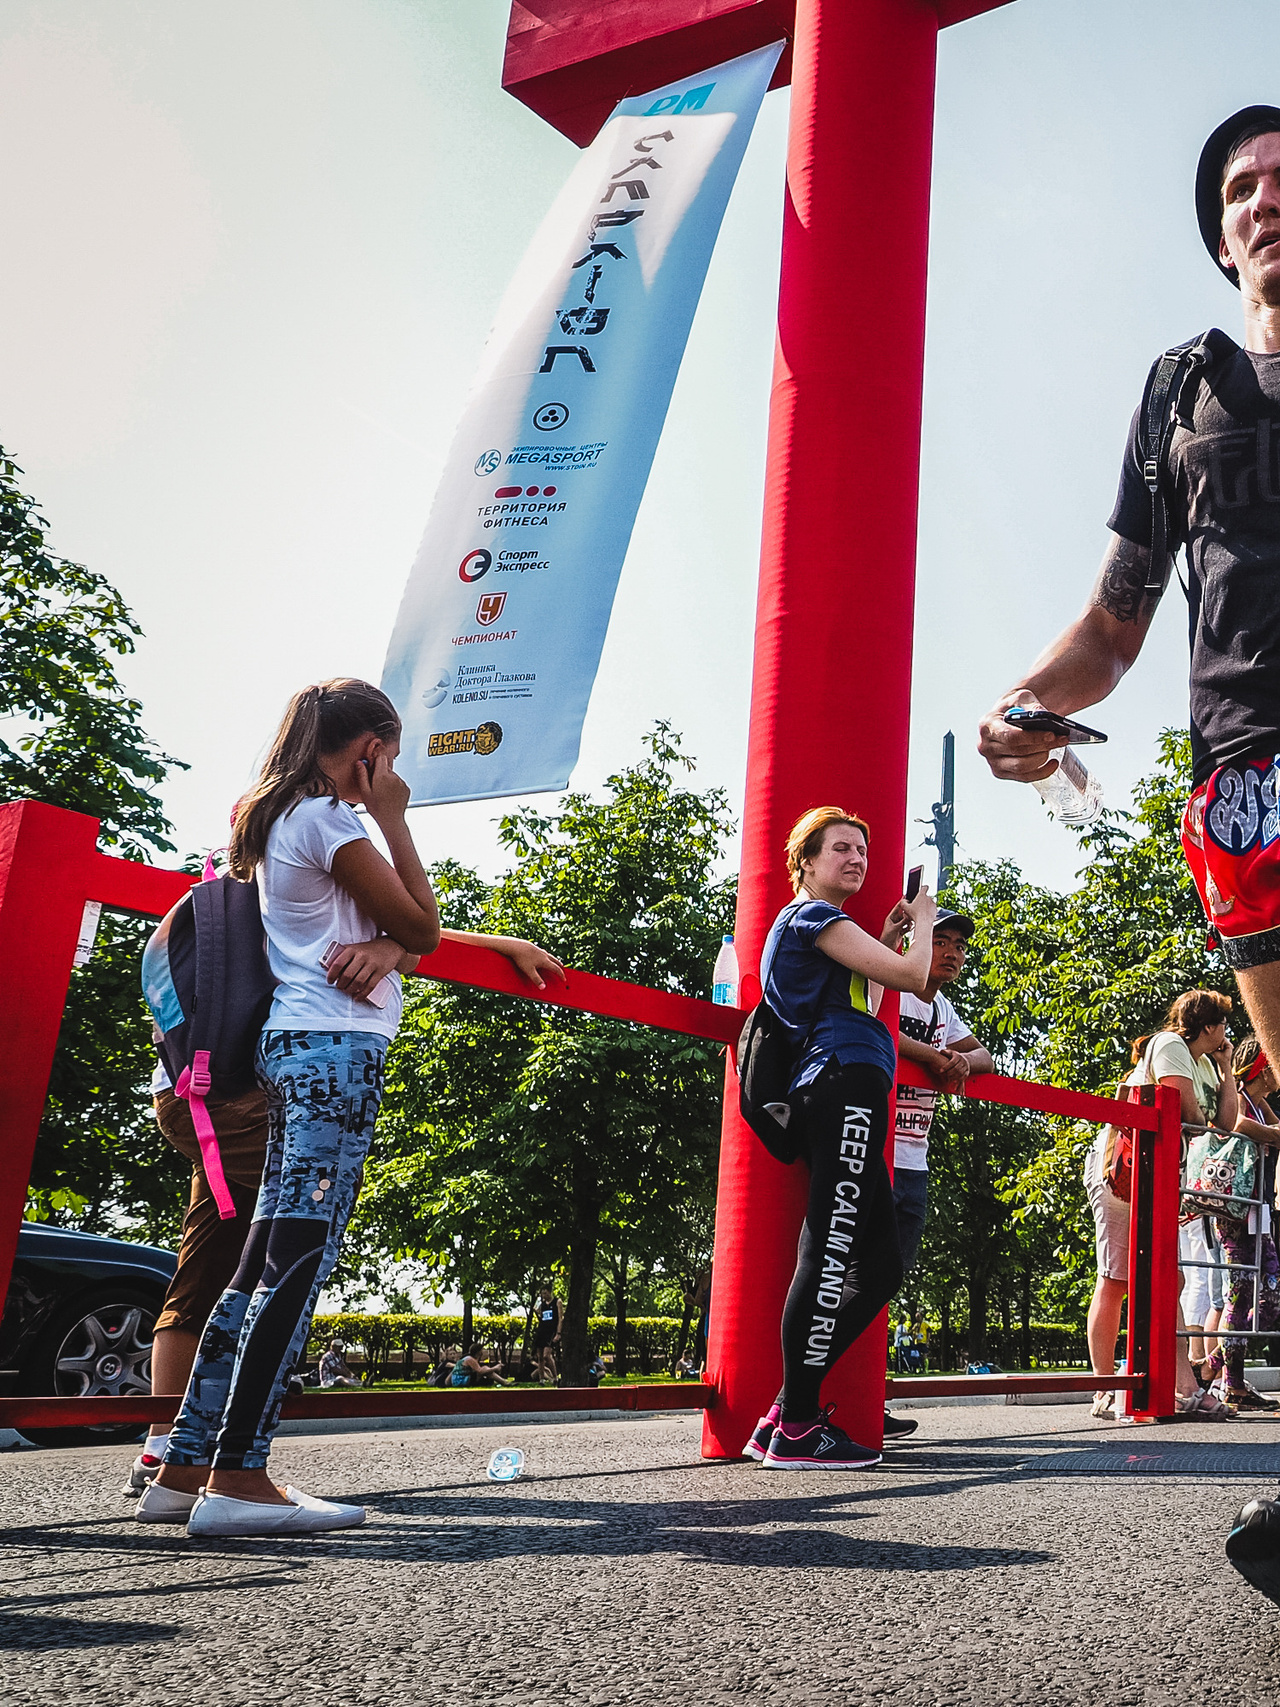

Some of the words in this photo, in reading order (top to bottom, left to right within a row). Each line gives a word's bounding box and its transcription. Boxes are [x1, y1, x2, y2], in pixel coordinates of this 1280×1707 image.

[505, 449, 604, 464] MEGASPORT
[478, 502, 567, 516] ТЕРРИТОРИЯ
[483, 516, 549, 529] ФИТНЕСА
[498, 550, 538, 562] Спорт
[494, 561, 550, 573] Экспресс
[451, 630, 518, 646] ЧЕМПИОНАТ
[457, 664, 496, 676] Клиника
[454, 675, 492, 689] Доктора
[494, 672, 536, 683] Глазкова
[452, 690, 489, 704] KOLENO.SU
[430, 730, 475, 748] FIGHT
[428, 742, 473, 756] WEAR.RU
[840, 1105, 872, 1174] KEEP
[826, 1181, 861, 1254] CALM
[817, 1254, 846, 1309] AND
[803, 1315, 836, 1366] RUN
